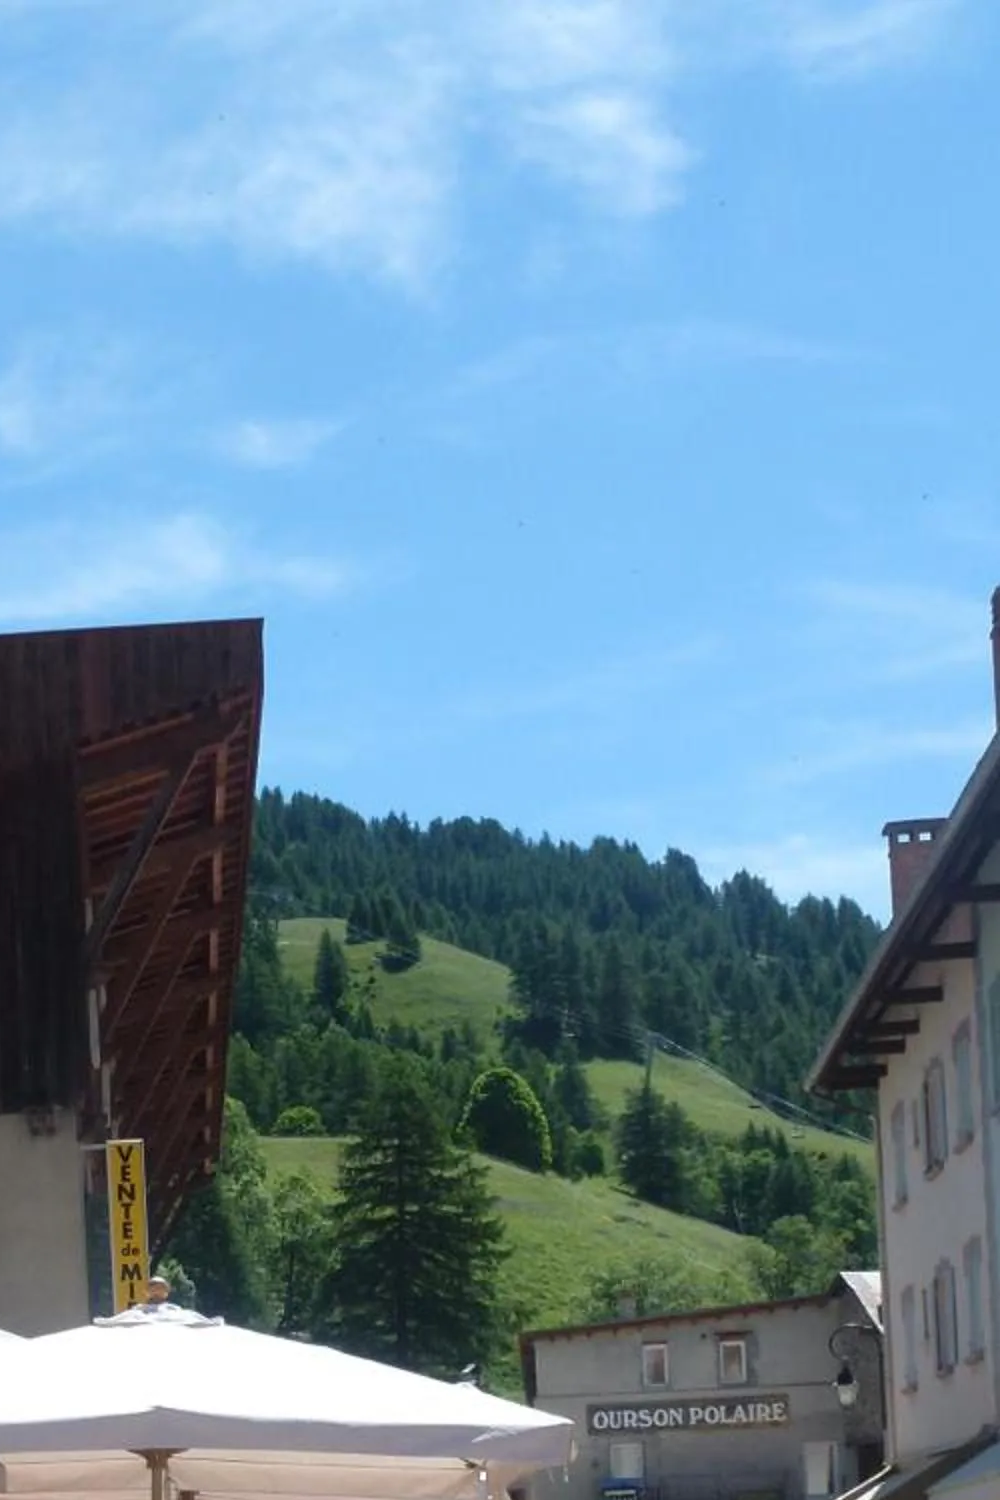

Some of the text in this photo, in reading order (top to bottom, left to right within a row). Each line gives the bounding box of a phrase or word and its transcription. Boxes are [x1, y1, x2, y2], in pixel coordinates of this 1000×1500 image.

[116, 1146, 137, 1240] VENTE
[121, 1243, 141, 1257] de
[593, 1402, 788, 1429] OURSON POLAIRE
